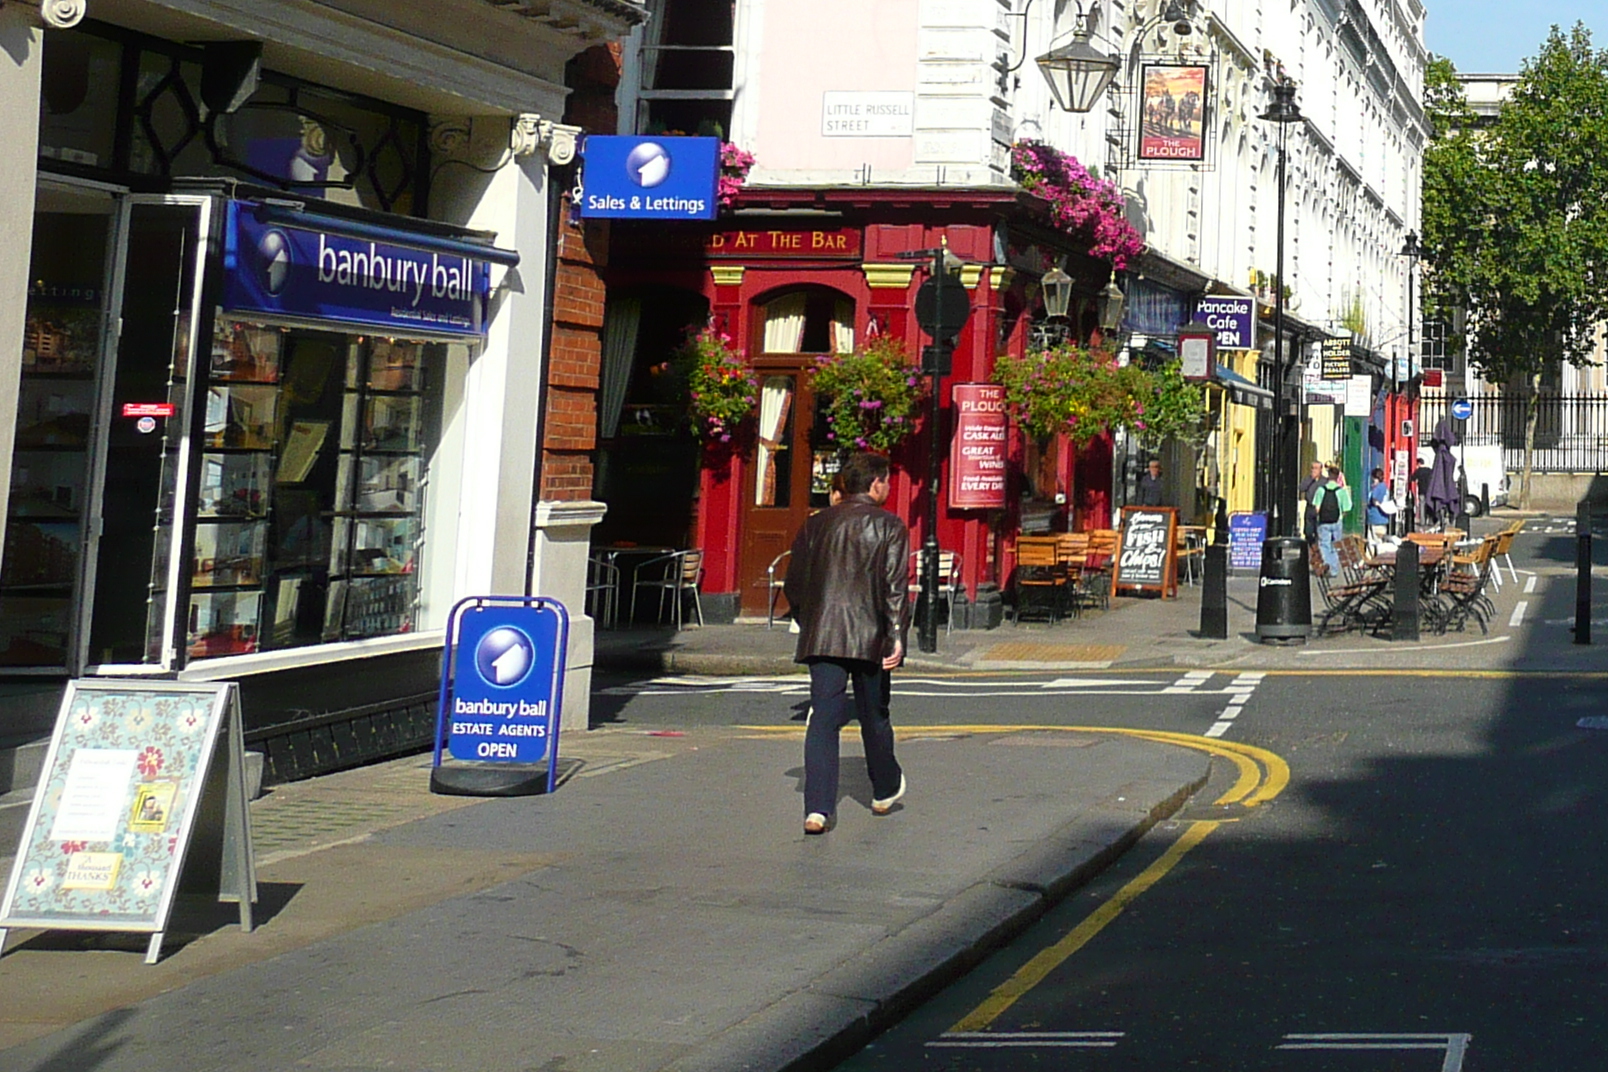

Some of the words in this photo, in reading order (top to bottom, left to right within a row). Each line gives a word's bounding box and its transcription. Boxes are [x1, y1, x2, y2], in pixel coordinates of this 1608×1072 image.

[827, 104, 861, 115] LITTLE
[866, 104, 910, 115] RUSSELL
[826, 120, 870, 131] STREET
[1146, 146, 1196, 157] PLOUGH
[588, 194, 625, 210] Sales
[630, 195, 641, 210] &
[645, 195, 705, 215] Lettings
[318, 233, 428, 307] banbury
[431, 253, 472, 301] ball
[1197, 300, 1248, 314] Pancake
[1207, 314, 1238, 329] Cafe
[1217, 331, 1240, 346] EN
[980, 389, 999, 398] THE
[962, 401, 1005, 412] PLOUG
[963, 432, 989, 440] CASK
[962, 446, 994, 455] GREAT
[961, 482, 990, 491] EVERY
[991, 482, 1005, 490] DA
[1126, 527, 1165, 547] FISH
[1120, 549, 1166, 571] Chips!
[455, 698, 518, 718] banbury
[519, 700, 546, 716] ball
[452, 722, 493, 736] ESTATE
[498, 724, 546, 737] AGENTS
[477, 743, 517, 757] OPEN
[68, 871, 109, 882] THANKS
